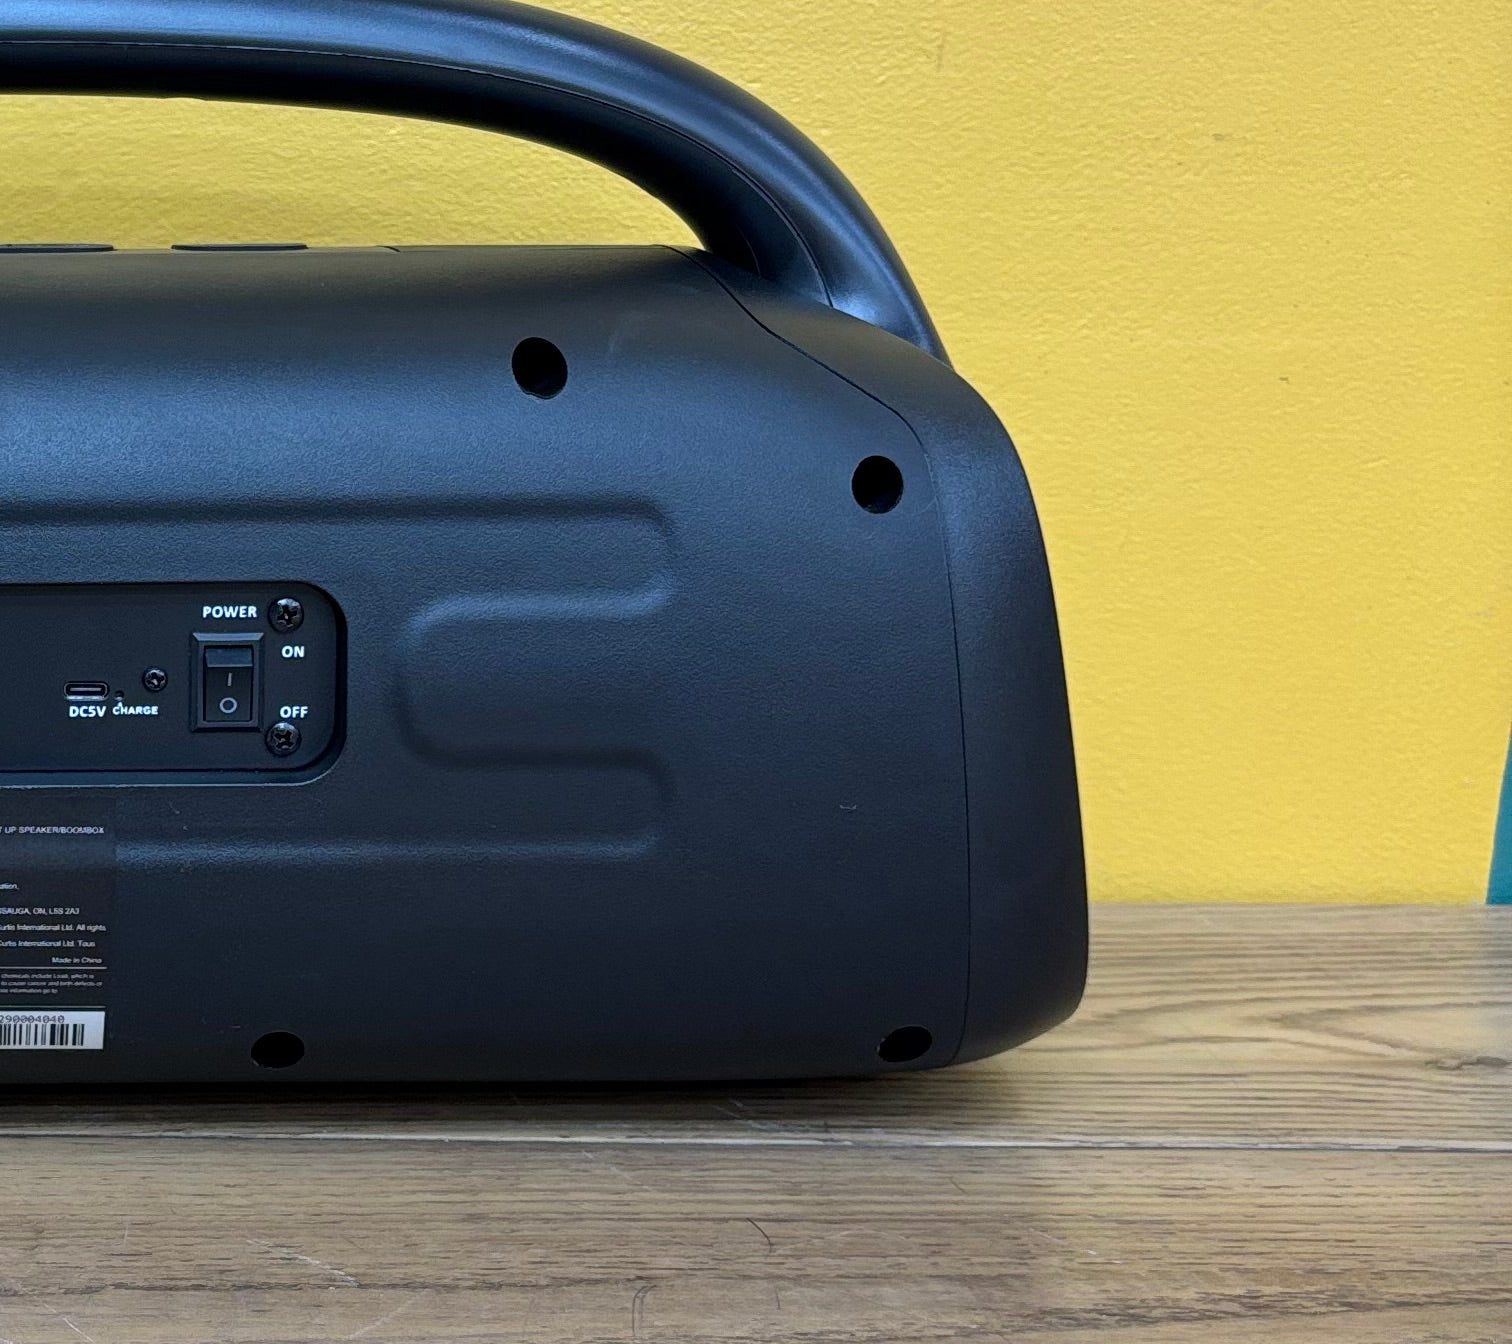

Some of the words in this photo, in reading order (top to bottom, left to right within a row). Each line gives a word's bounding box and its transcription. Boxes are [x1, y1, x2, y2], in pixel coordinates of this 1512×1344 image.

[202, 606, 257, 618] POWER
[281, 645, 305, 658] ON
[69, 706, 106, 717] DC5V
[112, 704, 158, 716] CHARGE
[279, 706, 308, 719] OFF
[5, 826, 16, 834] UP
